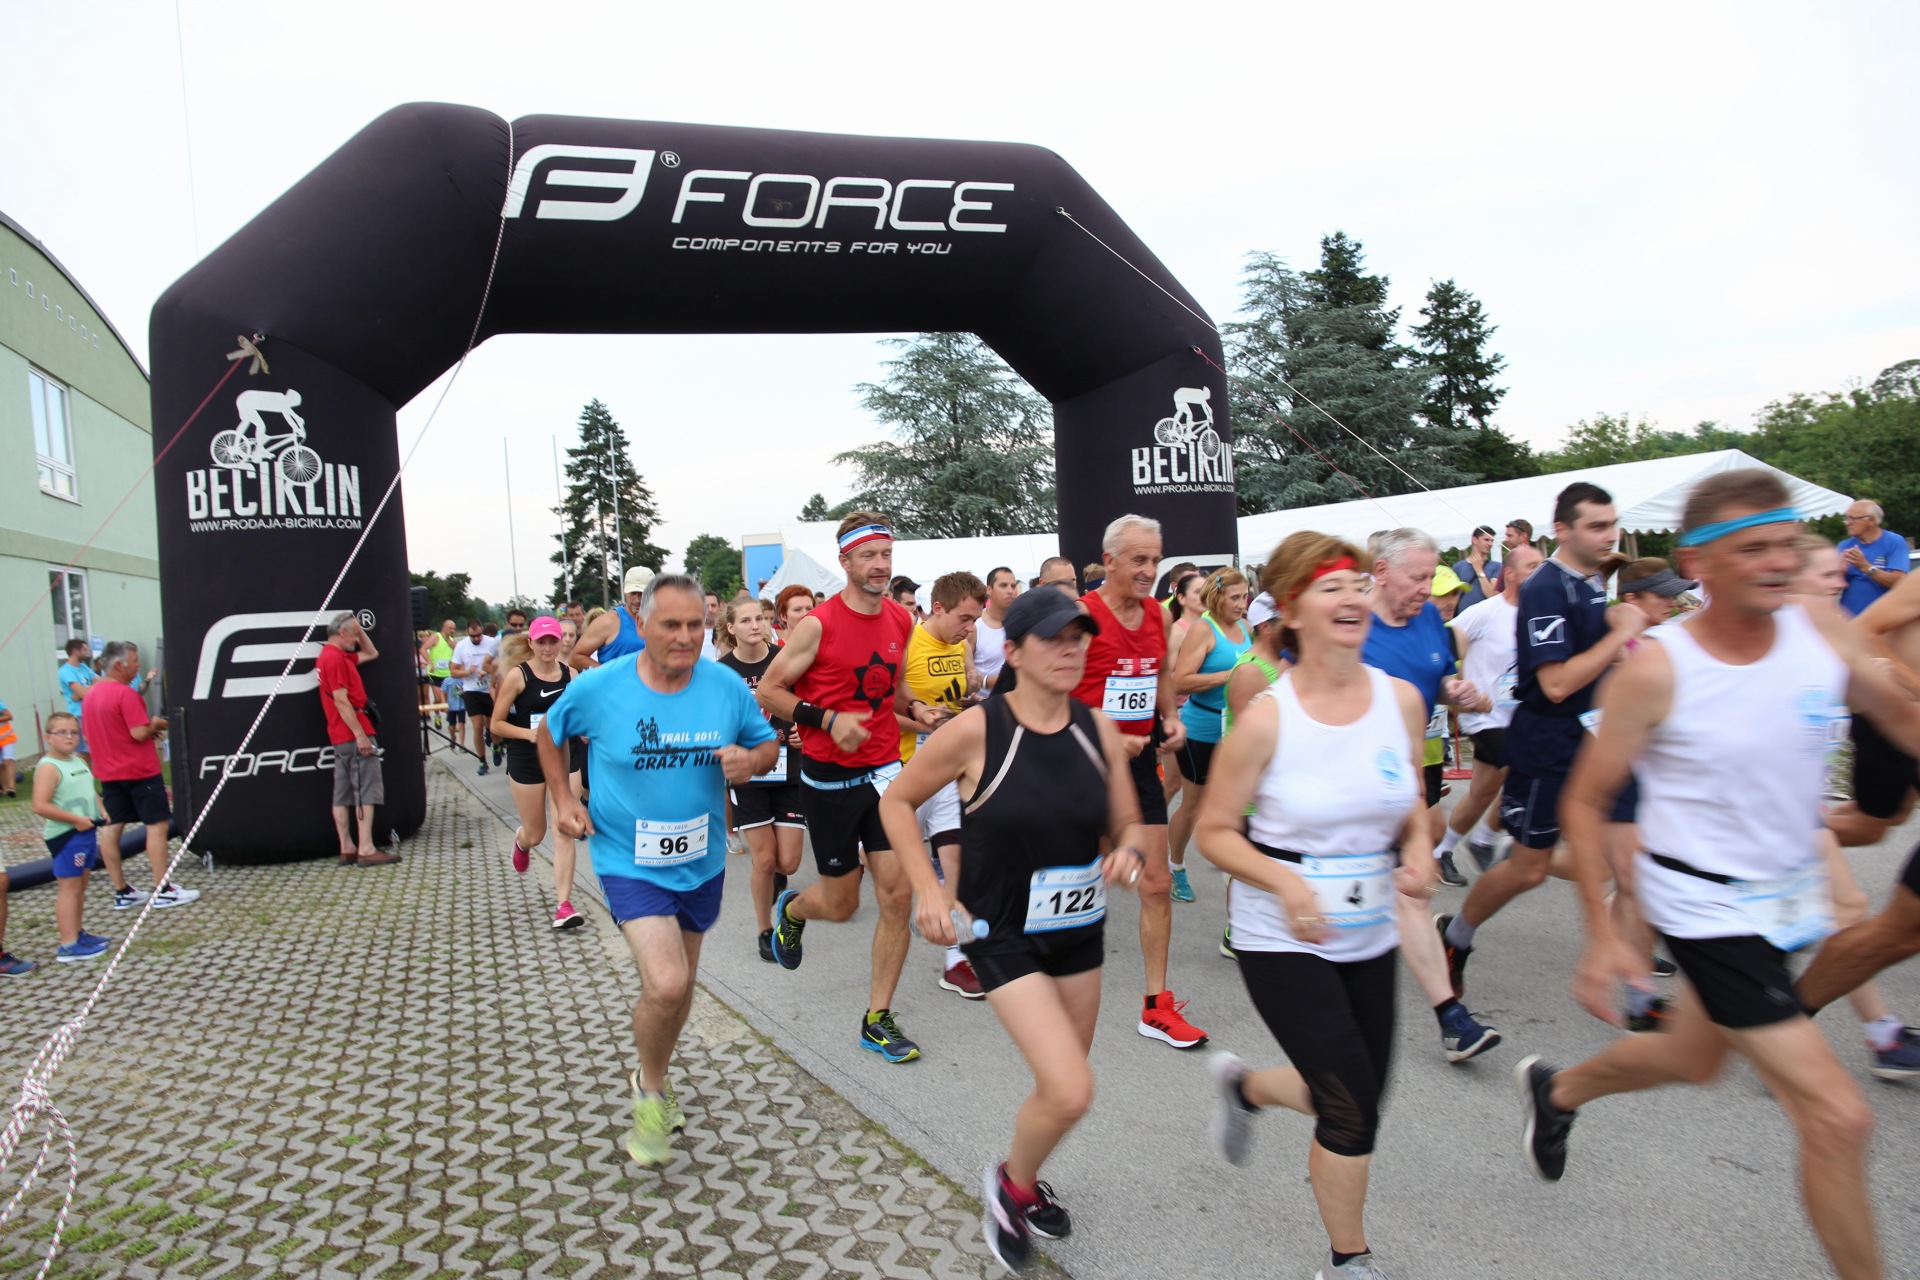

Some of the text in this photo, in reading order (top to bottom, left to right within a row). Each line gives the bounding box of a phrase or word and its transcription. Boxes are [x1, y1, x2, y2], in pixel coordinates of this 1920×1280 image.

[672, 169, 1015, 233] FORCE
[672, 236, 952, 255] COMPONENTS FOR YOU
[186, 461, 361, 520] BECIKLIN
[190, 518, 362, 533] WWW.PRODAJA-BICIKLA.COM
[1118, 692, 1147, 709] 168
[660, 732, 690, 744] TRAIL
[634, 752, 689, 770] CRAZY
[660, 836, 688, 855] 96
[1049, 886, 1095, 915] 122
